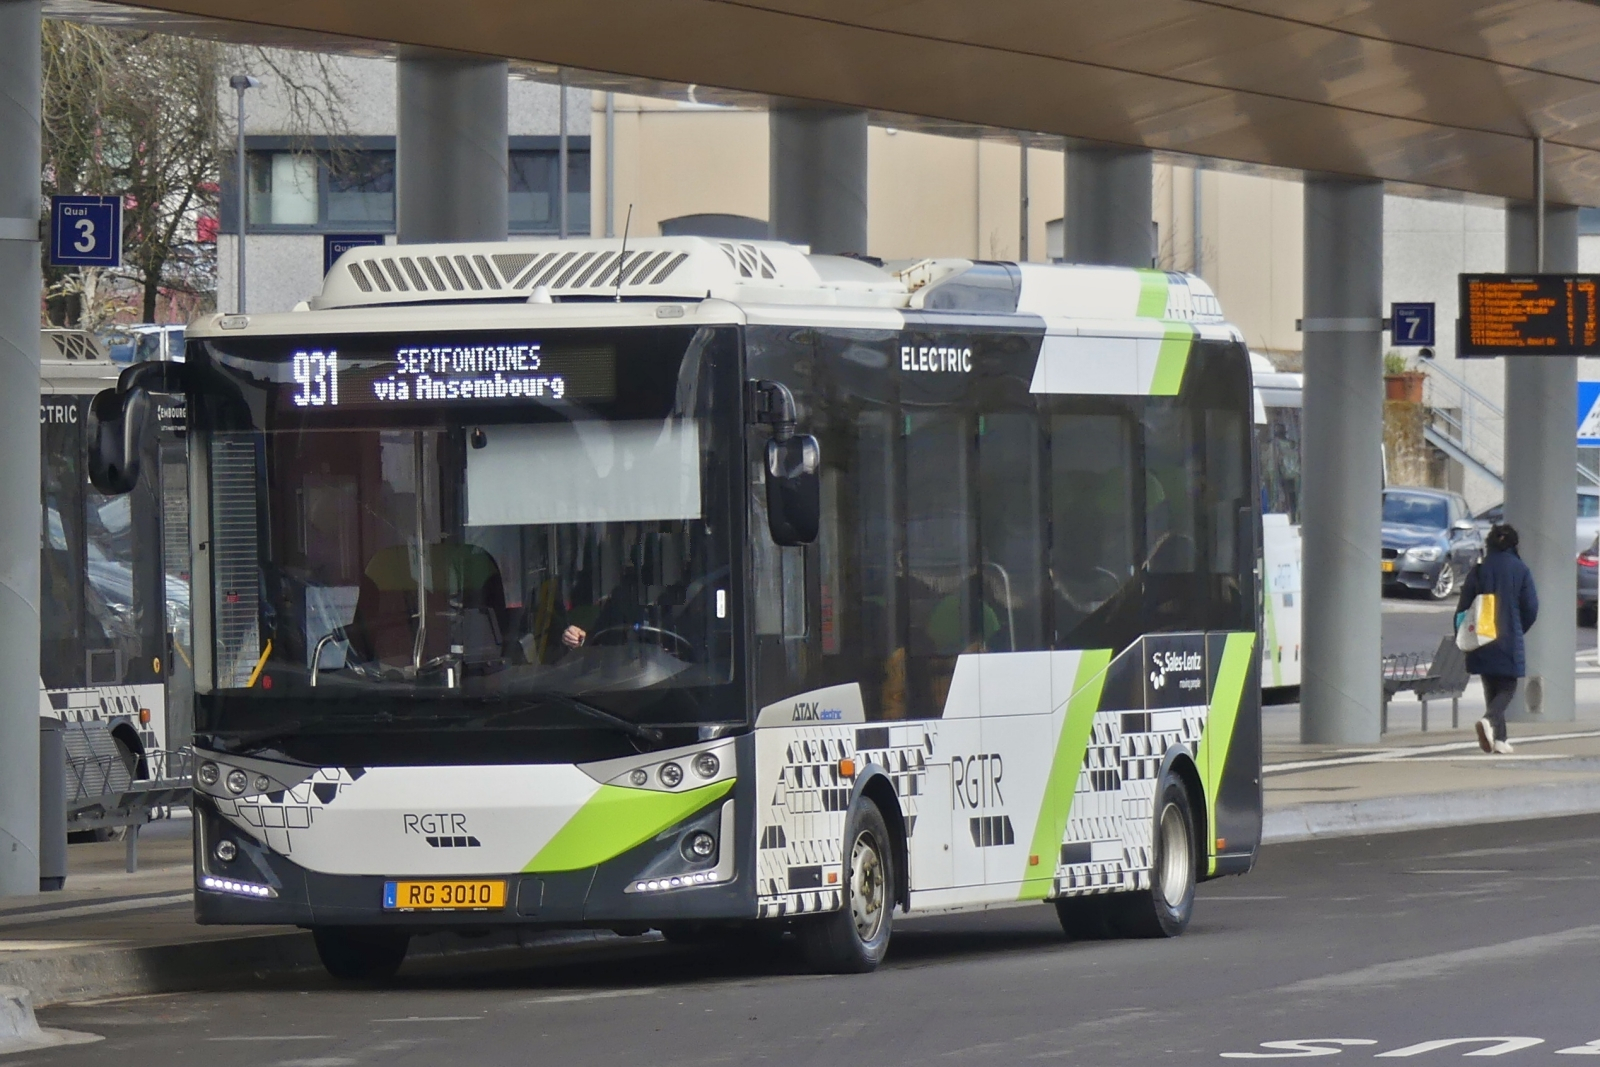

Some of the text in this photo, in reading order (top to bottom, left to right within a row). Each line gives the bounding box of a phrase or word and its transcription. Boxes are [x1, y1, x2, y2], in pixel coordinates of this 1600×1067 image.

[64, 207, 88, 216] Quai
[73, 219, 97, 253] 3
[1405, 318, 1420, 339] 7
[901, 346, 972, 373] ELECTRIC
[293, 346, 541, 406] 931 SEPTFONTAINES
[374, 373, 564, 400] via Ansembourg
[1165, 651, 1202, 672] Sales-Lentz
[792, 702, 819, 721] ATAK
[951, 753, 1004, 811] RGTR
[403, 813, 467, 834] RGTR
[388, 884, 491, 905] L RG 3010
